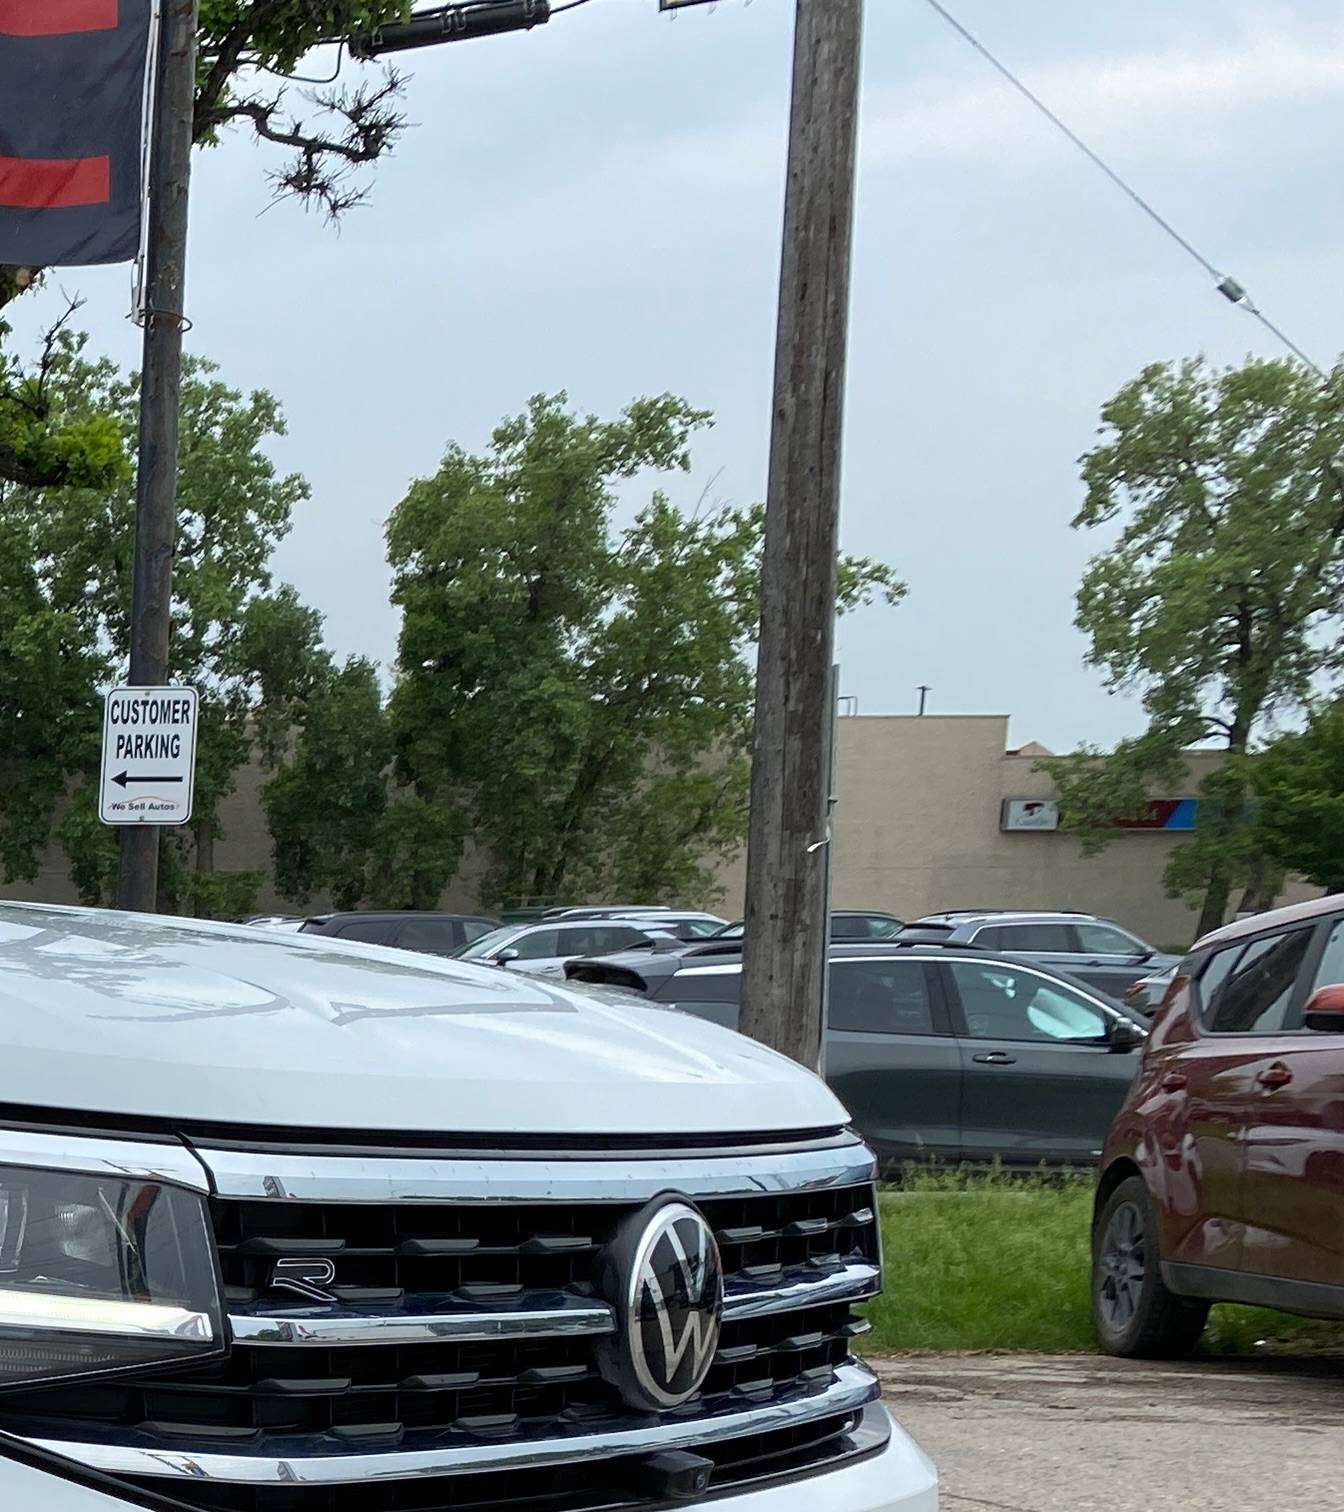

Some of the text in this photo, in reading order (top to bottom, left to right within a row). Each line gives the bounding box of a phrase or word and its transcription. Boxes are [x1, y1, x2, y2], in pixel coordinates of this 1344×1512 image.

[110, 699, 190, 725] CUSTOMER
[115, 734, 181, 759] PARKING
[112, 802, 176, 811] We Sell Autos
[270, 1258, 336, 1302] R
